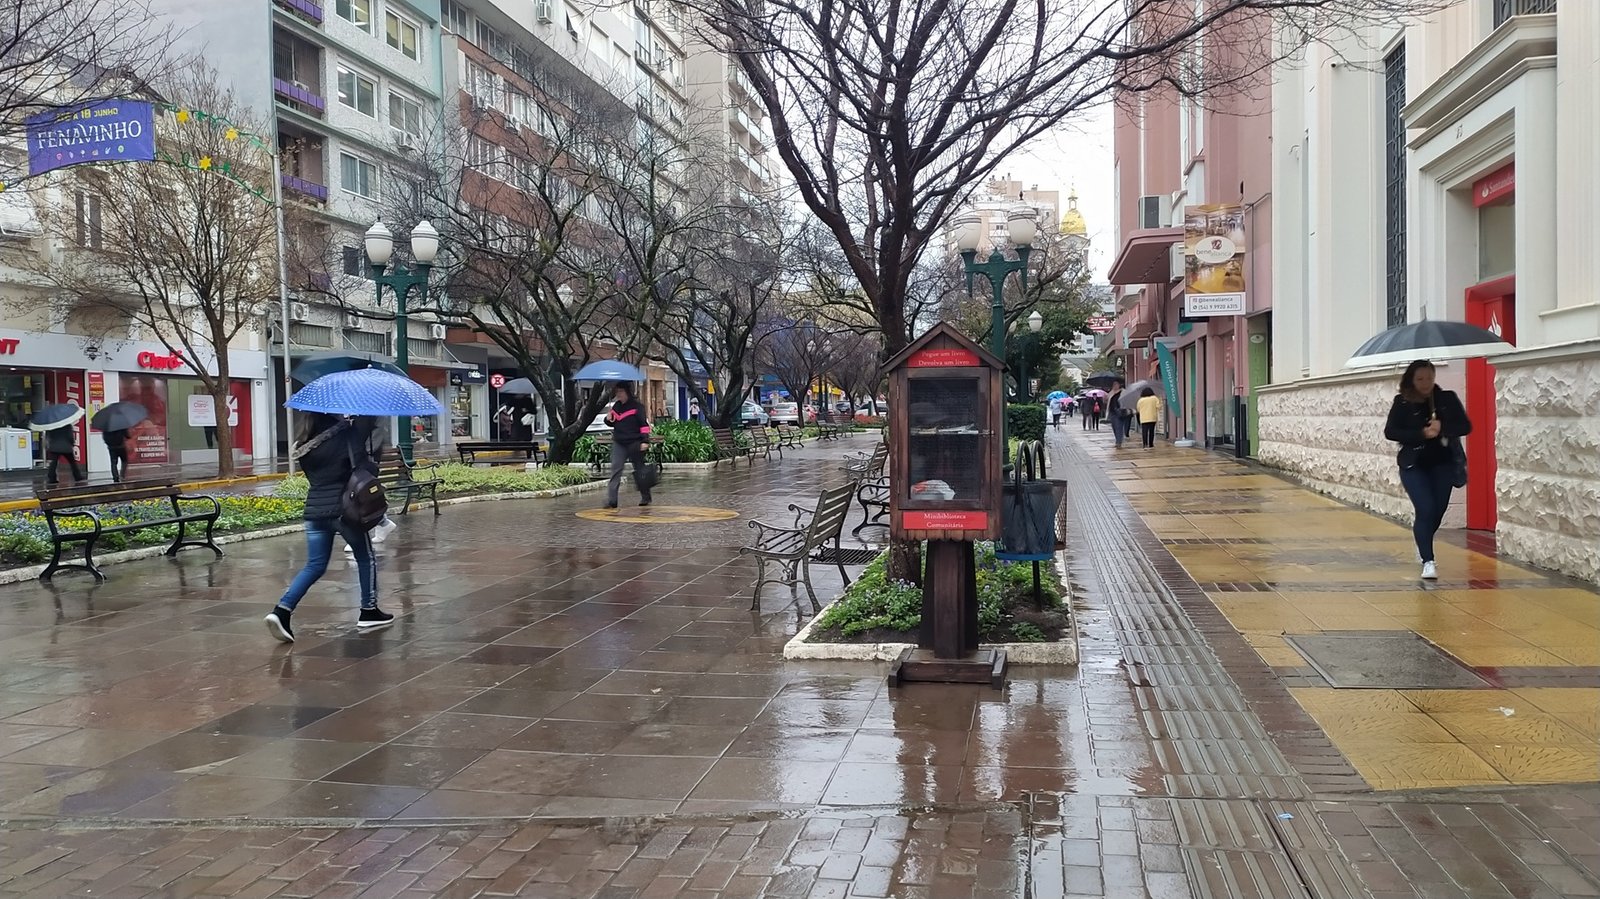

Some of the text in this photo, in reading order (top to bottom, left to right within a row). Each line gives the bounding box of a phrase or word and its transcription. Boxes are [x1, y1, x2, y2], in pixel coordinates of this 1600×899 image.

[81, 108, 91, 119] 18
[94, 107, 119, 117] JUNHO
[37, 119, 142, 149] FENAVINHO
[1489, 172, 1515, 194] Santande
[137, 351, 181, 370] Claro
